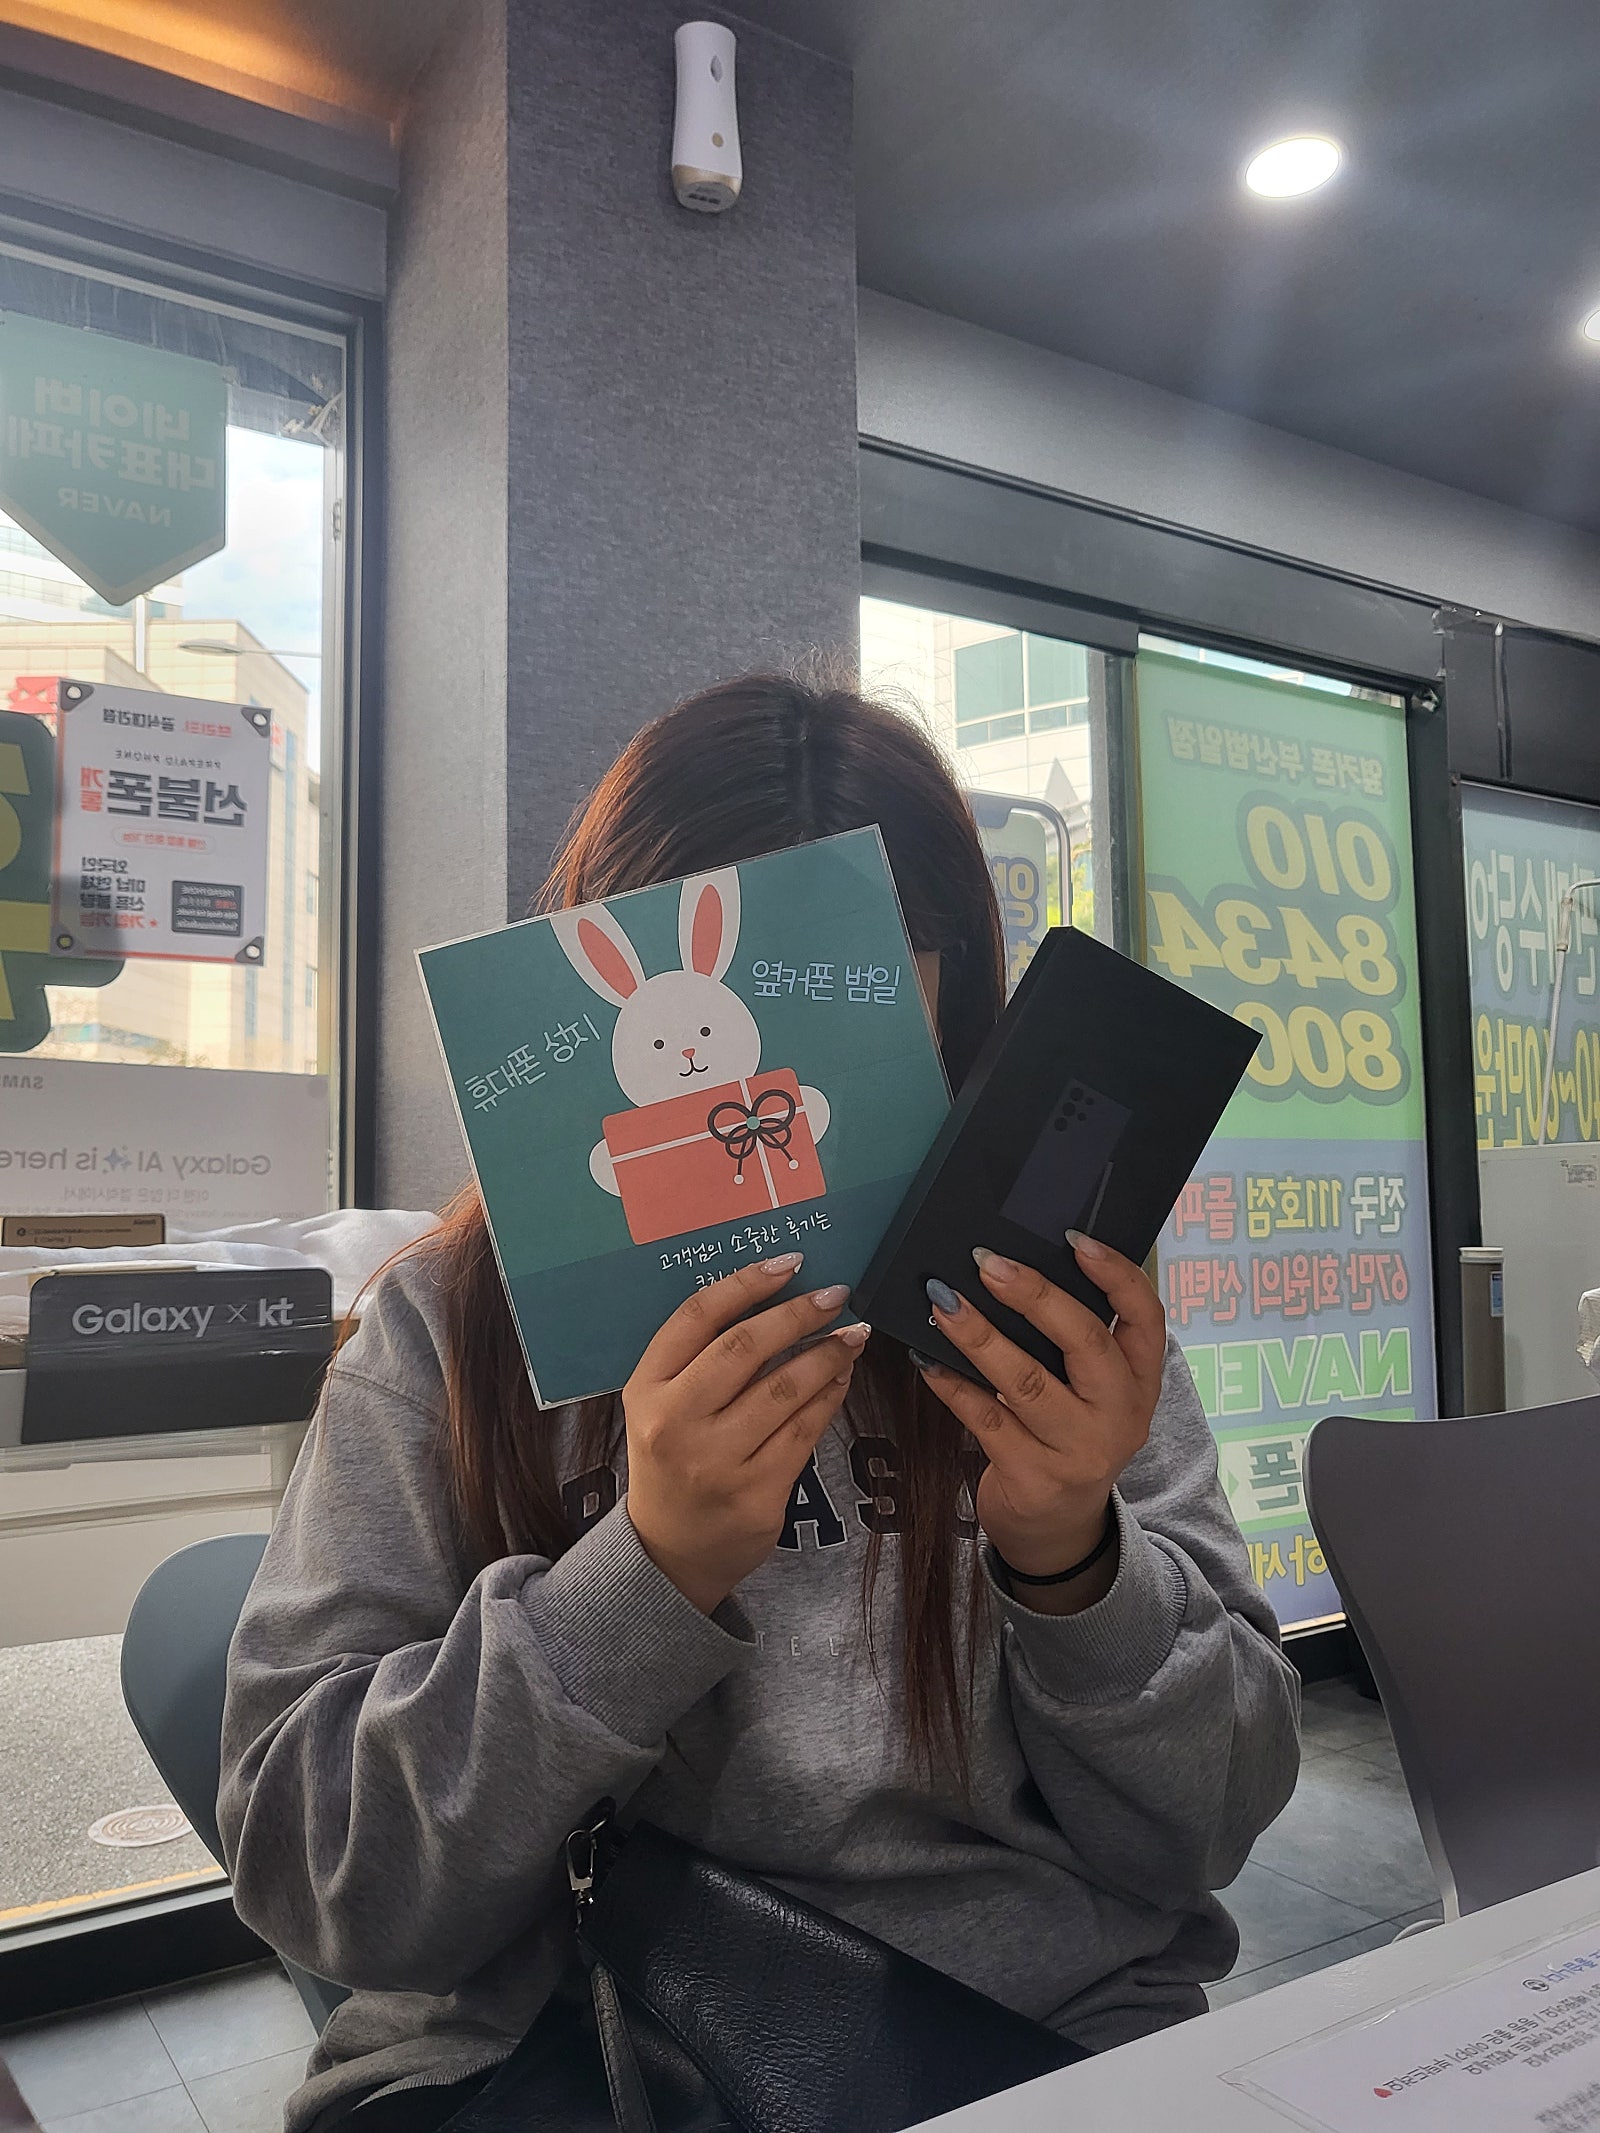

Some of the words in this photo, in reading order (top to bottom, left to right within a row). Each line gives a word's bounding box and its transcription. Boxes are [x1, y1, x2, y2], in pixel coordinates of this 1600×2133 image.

[751, 959, 835, 1002] 옆커폰
[845, 964, 901, 1005] 범일
[464, 1043, 547, 1113] 휴대폰
[544, 1013, 601, 1064] 성지
[658, 1241, 724, 1271] 고객님의
[730, 1225, 781, 1255] 소중한
[784, 1210, 833, 1242] 후기는
[71, 1302, 215, 1338] Galaxy
[258, 1297, 295, 1327] kt
[1481, 2028, 1515, 2046] 좋은
[1507, 2017, 1539, 2034] 등등
[1444, 2041, 1490, 2064] 이야기
[1383, 2057, 1453, 2092] 부탁드려요
